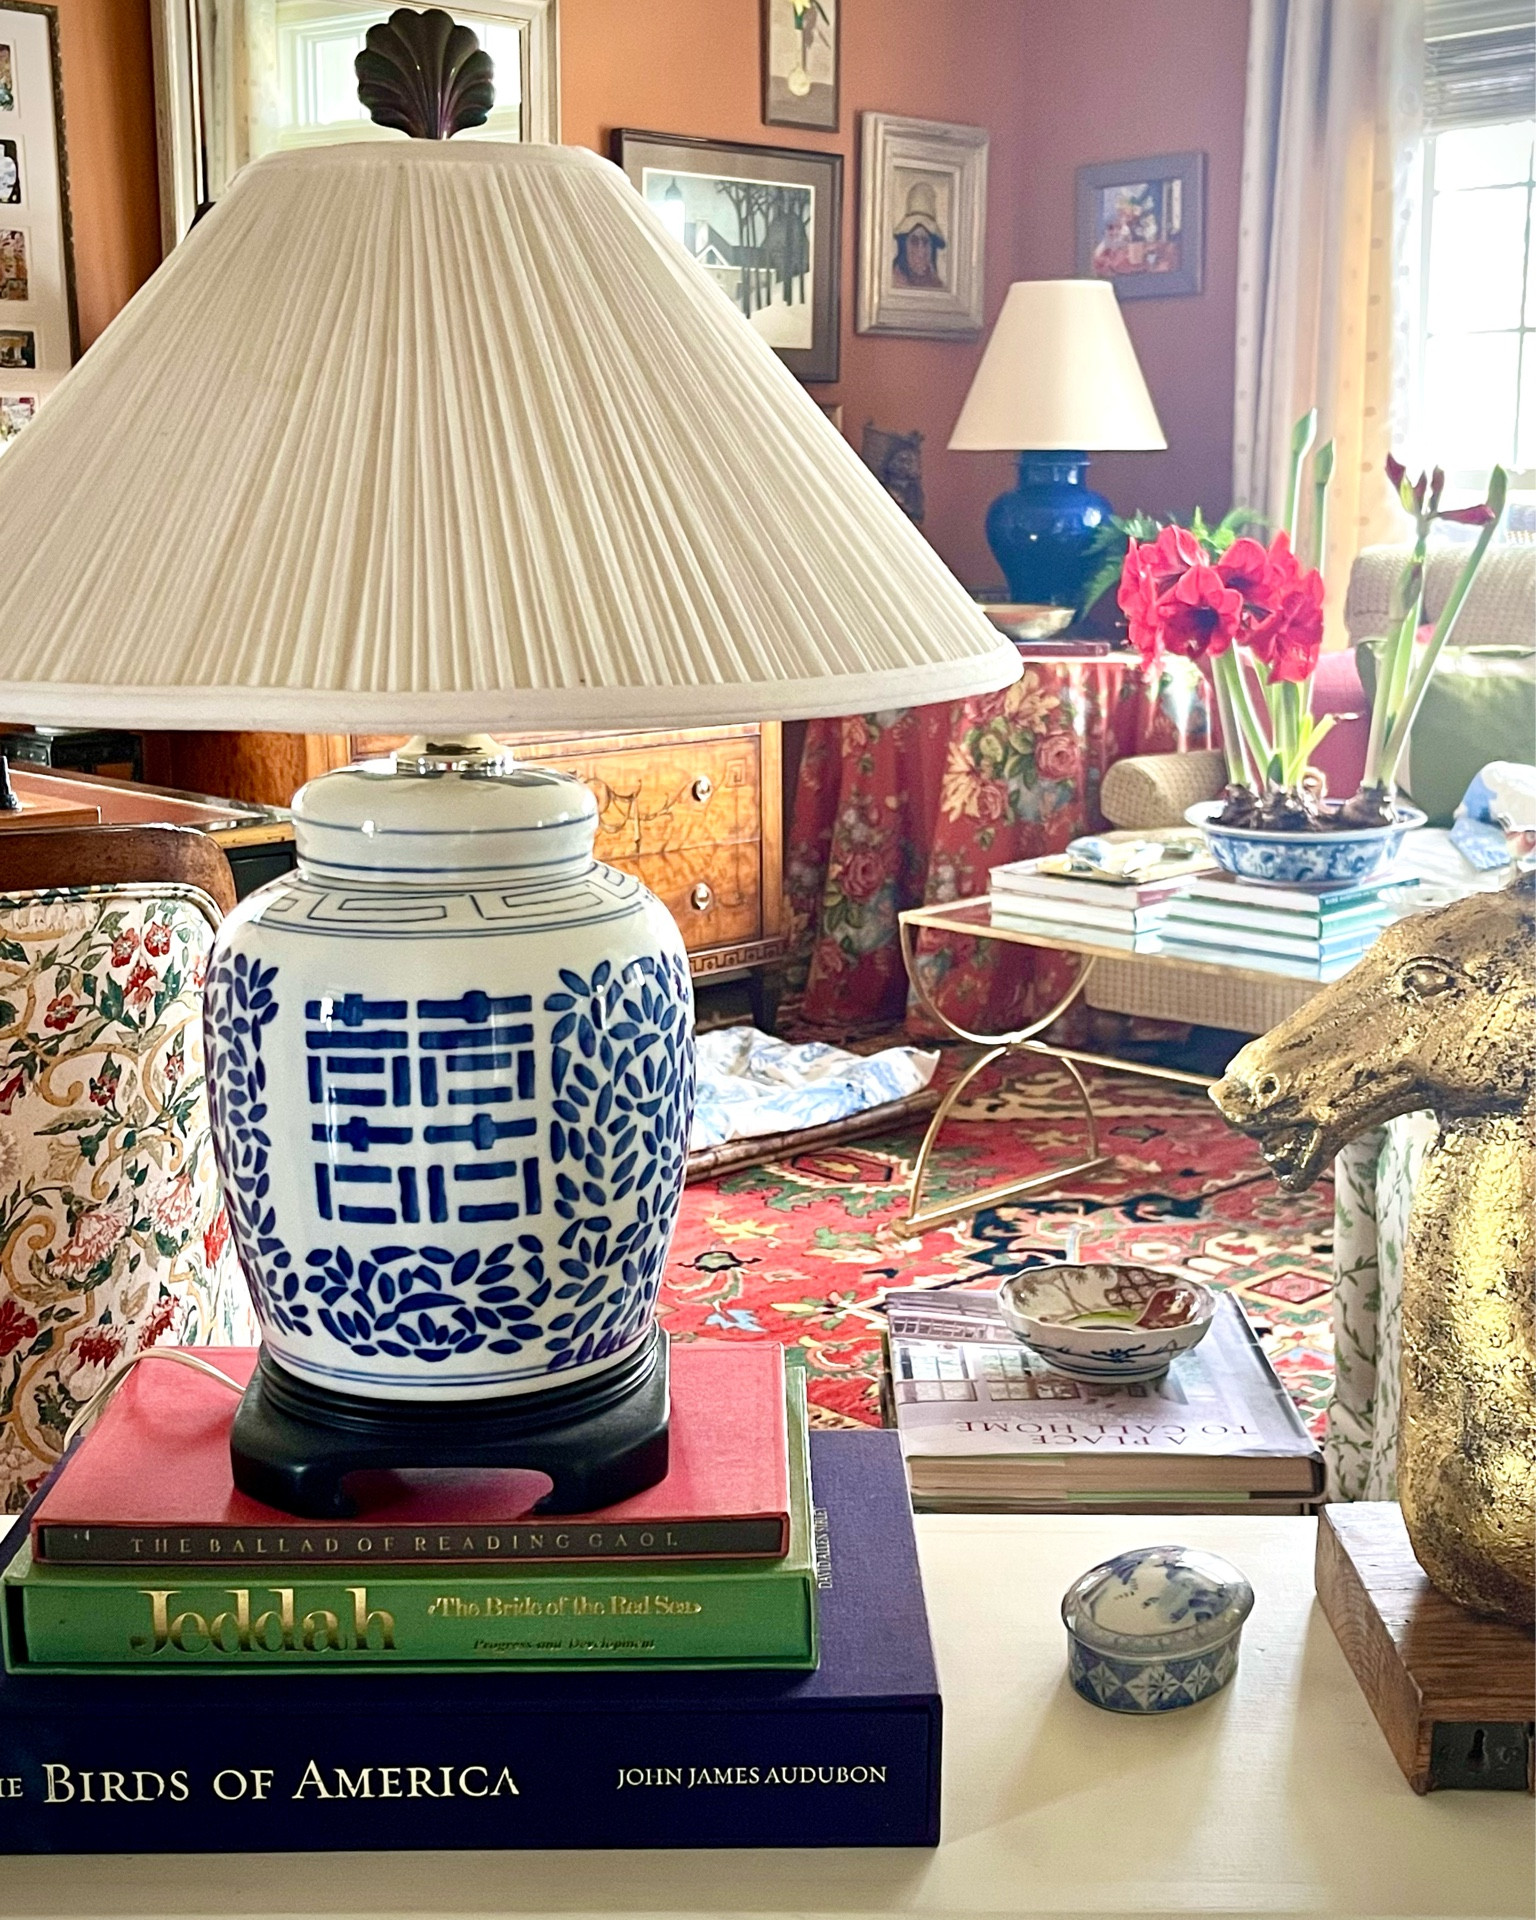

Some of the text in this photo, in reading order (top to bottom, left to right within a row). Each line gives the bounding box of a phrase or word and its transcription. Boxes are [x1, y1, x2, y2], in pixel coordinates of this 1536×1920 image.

[955, 1421, 1258, 1435] TO CALL HOME
[1031, 1434, 1188, 1446] A PLACE
[131, 1532, 678, 1553] THE BALLAD OF READING GAOL
[818, 1562, 832, 1588] DAVID
[436, 1596, 480, 1617] The
[485, 1596, 542, 1617] Bride
[546, 1596, 569, 1616] of
[573, 1595, 605, 1616] the
[609, 1595, 650, 1615] Red
[129, 1587, 397, 1656] Jeddah
[473, 1637, 656, 1655] Progress and Development
[616, 1765, 888, 1790] JOHN JAMES AUDUBON
